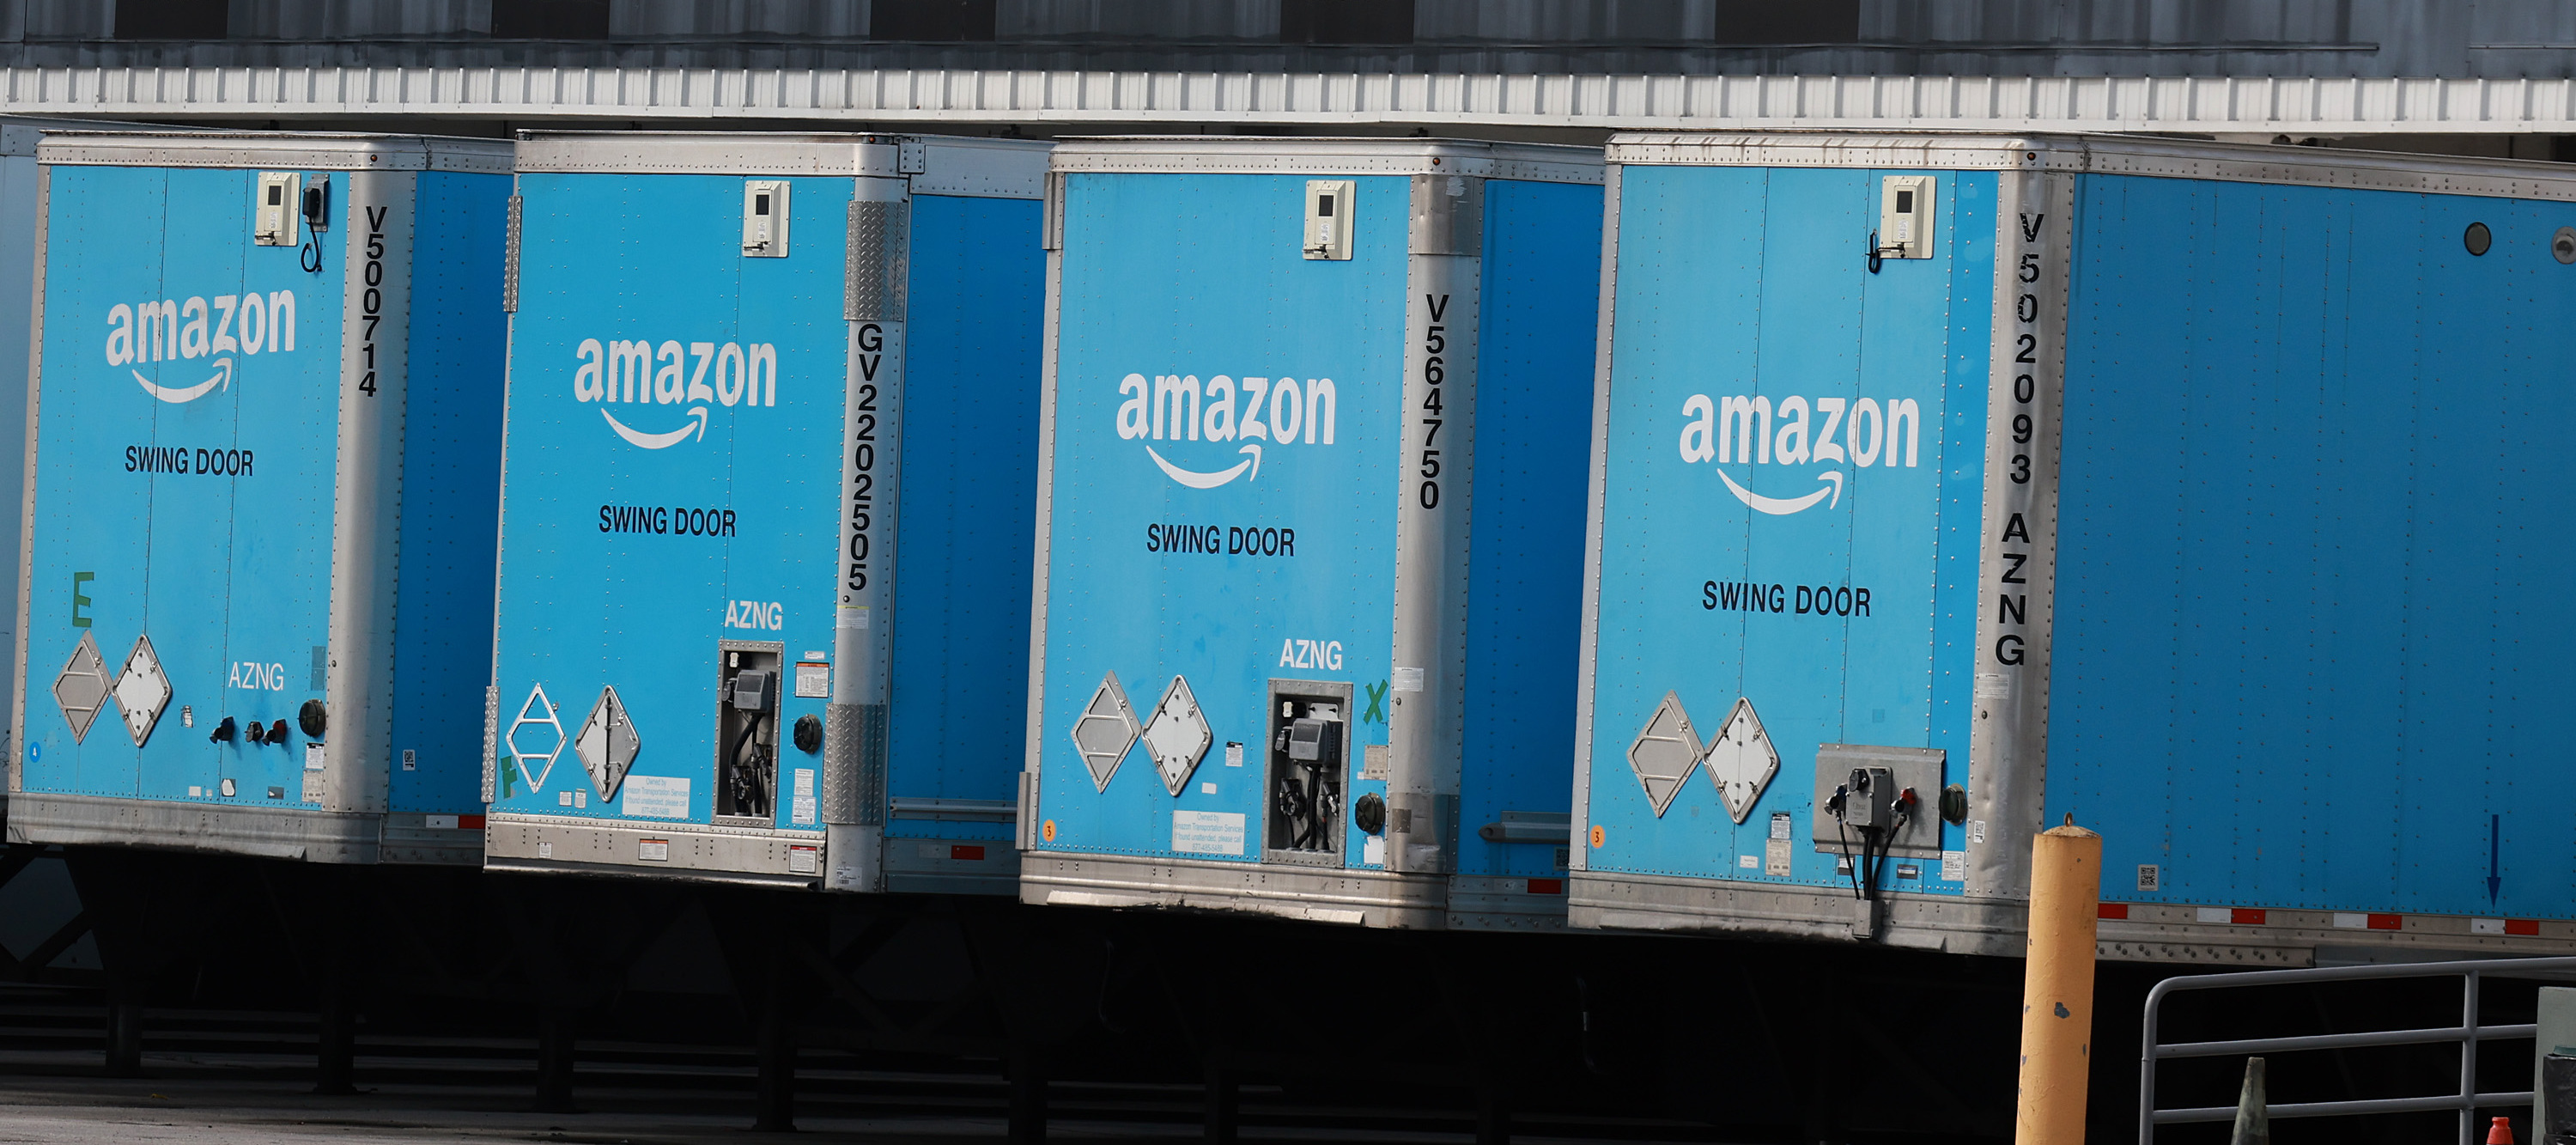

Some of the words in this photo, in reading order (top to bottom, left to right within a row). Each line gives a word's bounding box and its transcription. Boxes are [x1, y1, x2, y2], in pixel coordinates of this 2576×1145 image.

[358, 205, 388, 398] V500714
[106, 289, 295, 367] amazon
[2009, 212, 2045, 484] V502093
[574, 338, 777, 407] amazon
[1116, 373, 1336, 445] amazon
[1419, 294, 1450, 510] V564750
[1679, 393, 1920, 468] amazon
[125, 445, 189, 474] SWING
[196, 448, 253, 477] DOOR
[848, 323, 883, 591] GV2202505
[598, 504, 667, 534] SWING
[674, 508, 737, 538] DOOR
[1146, 523, 1220, 555] SWING
[1228, 527, 1295, 557] DOOR
[72, 571, 94, 628] E
[1702, 580, 1784, 613] SWING
[1795, 585, 1872, 617] DOOR
[1996, 512, 2031, 667] AZNG
[724, 600, 783, 630] AZNG
[1279, 638, 1343, 671] AZNG
[228, 661, 284, 691] AZNG
[1046, 825, 1053, 837] 3
[1197, 813, 1213, 821] Owned
[1224, 824, 1243, 833] Services
[1595, 830, 1601, 844] 3
